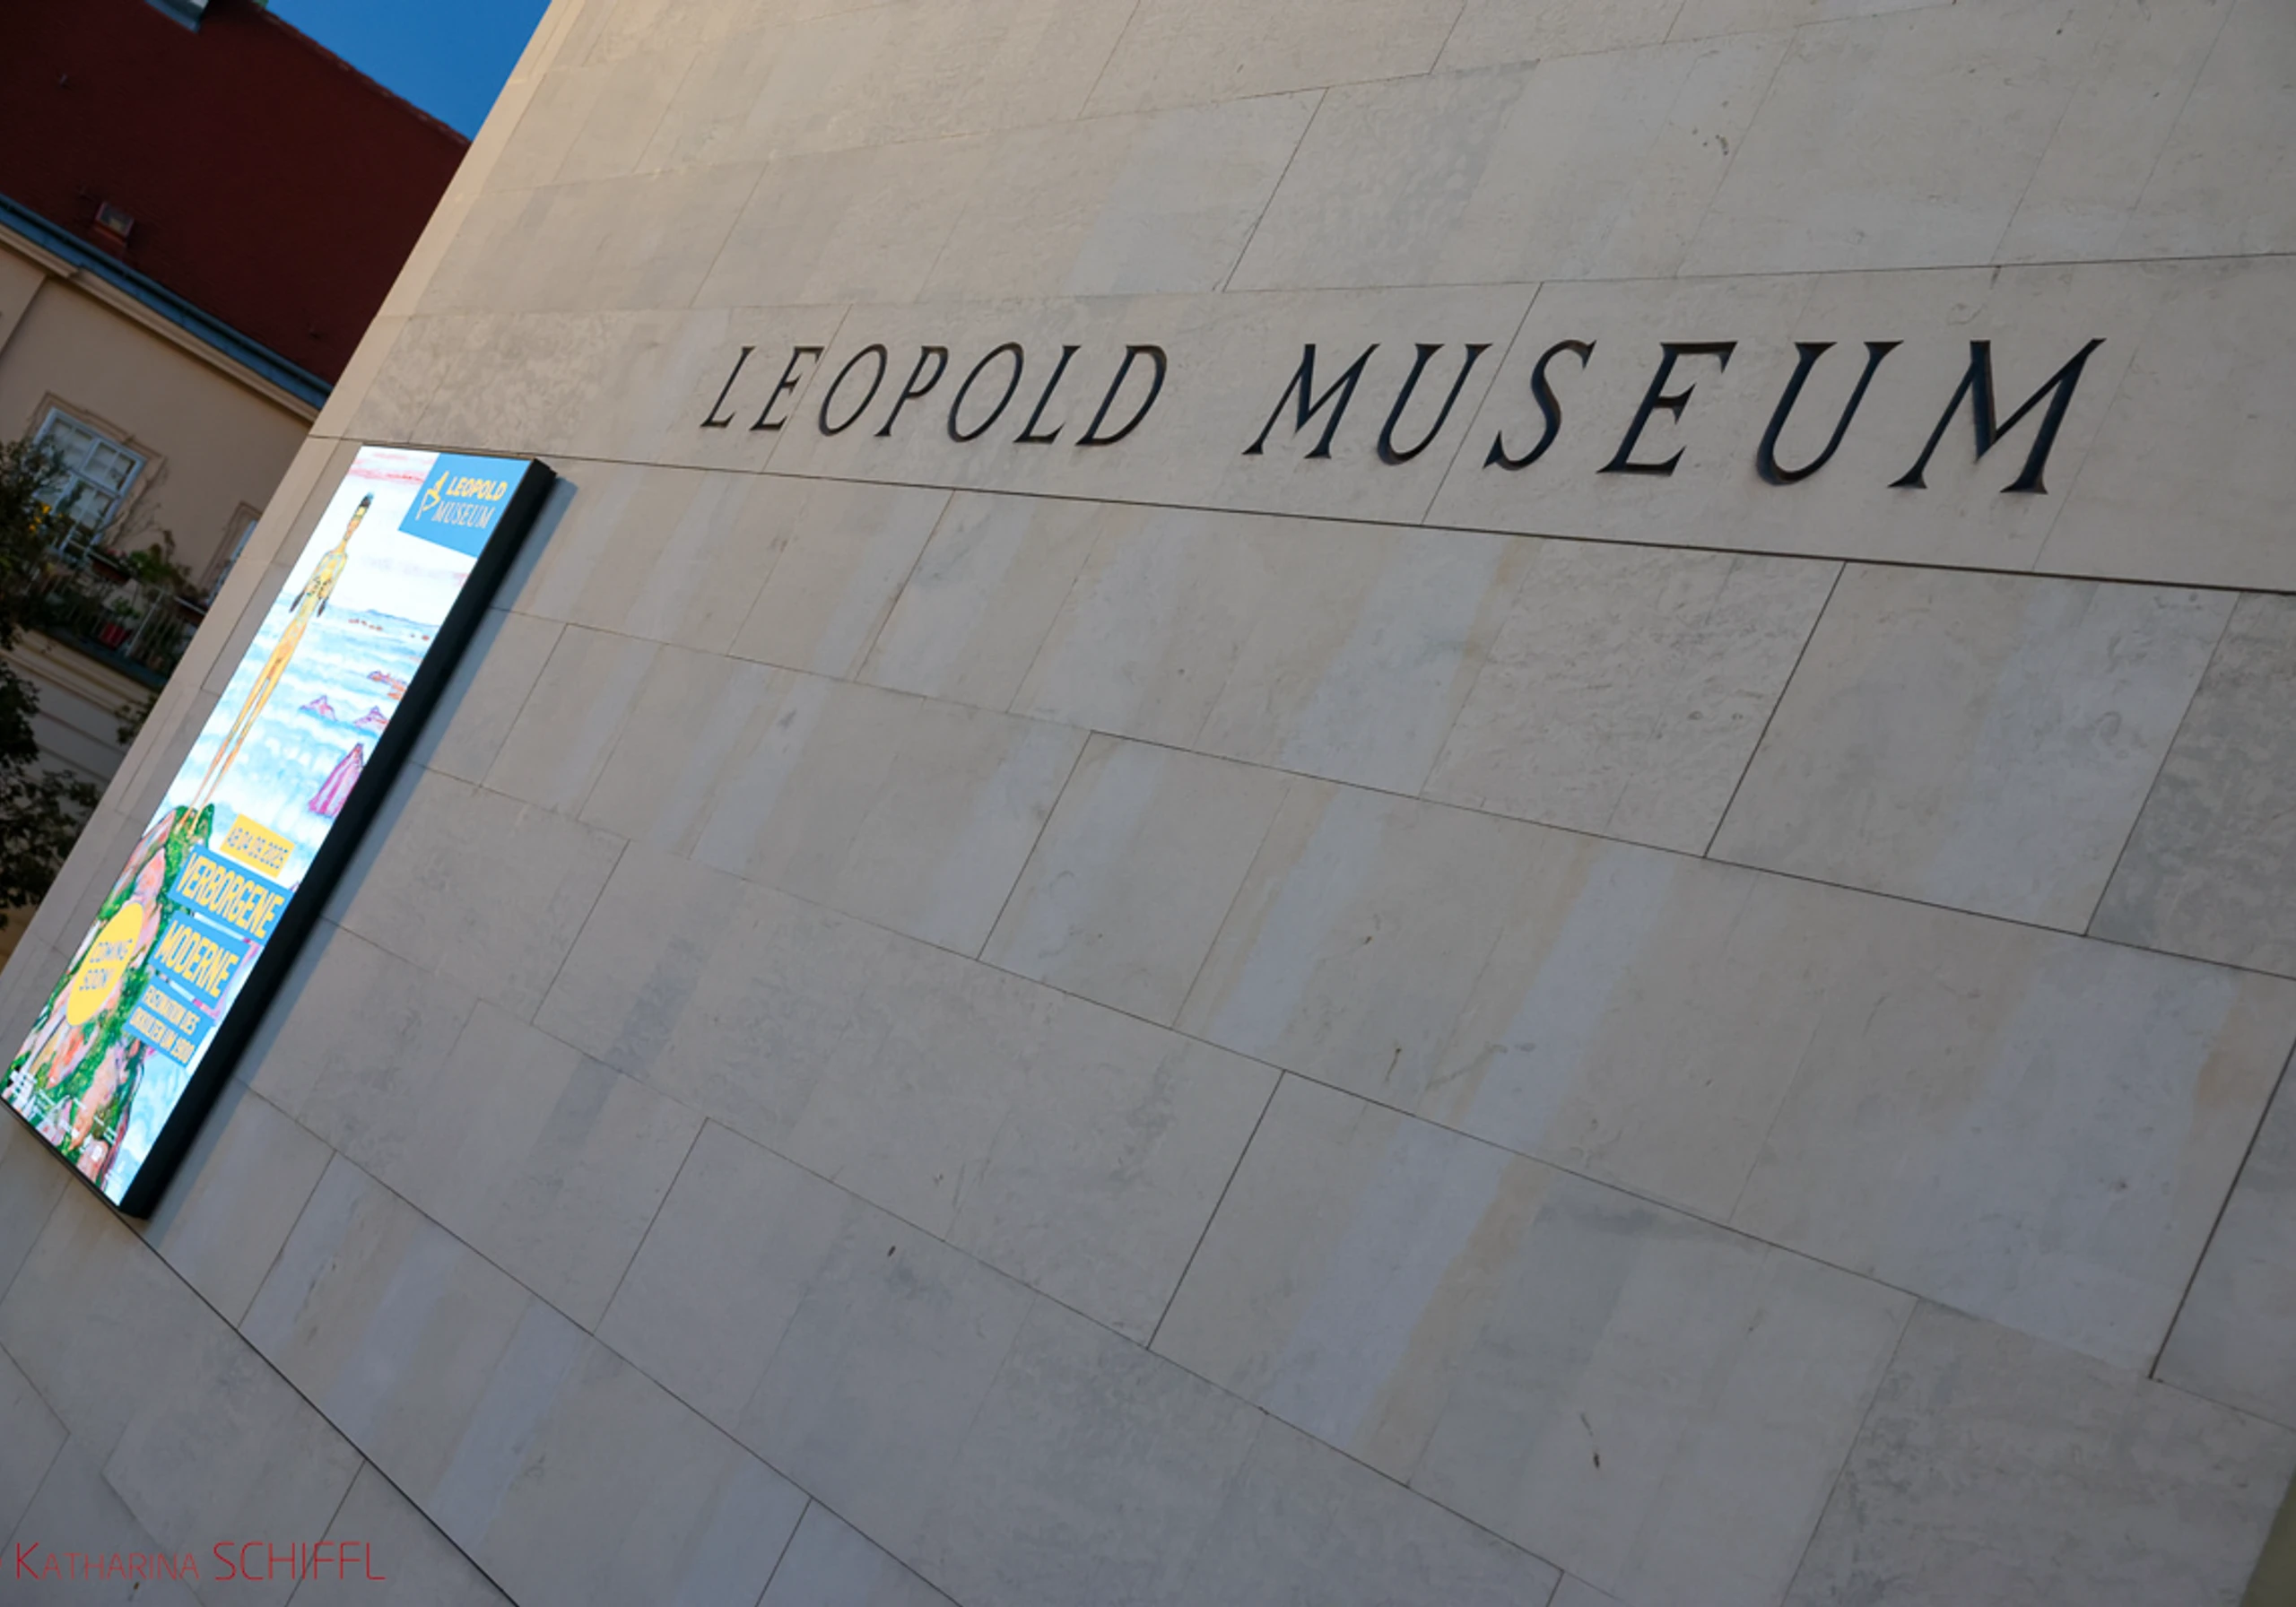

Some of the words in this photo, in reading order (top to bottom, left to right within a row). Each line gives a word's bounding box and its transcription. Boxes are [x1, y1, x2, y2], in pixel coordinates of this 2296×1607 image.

[700, 342, 1167, 447] LEOPOLD
[1241, 338, 2107, 495] MUSEUM
[432, 501, 495, 528] MUSEUM
[446, 477, 508, 500] LEOPOLD
[176, 852, 284, 939] VERBORGENE
[154, 920, 240, 997] MODERNE
[179, 1011, 200, 1036] DES
